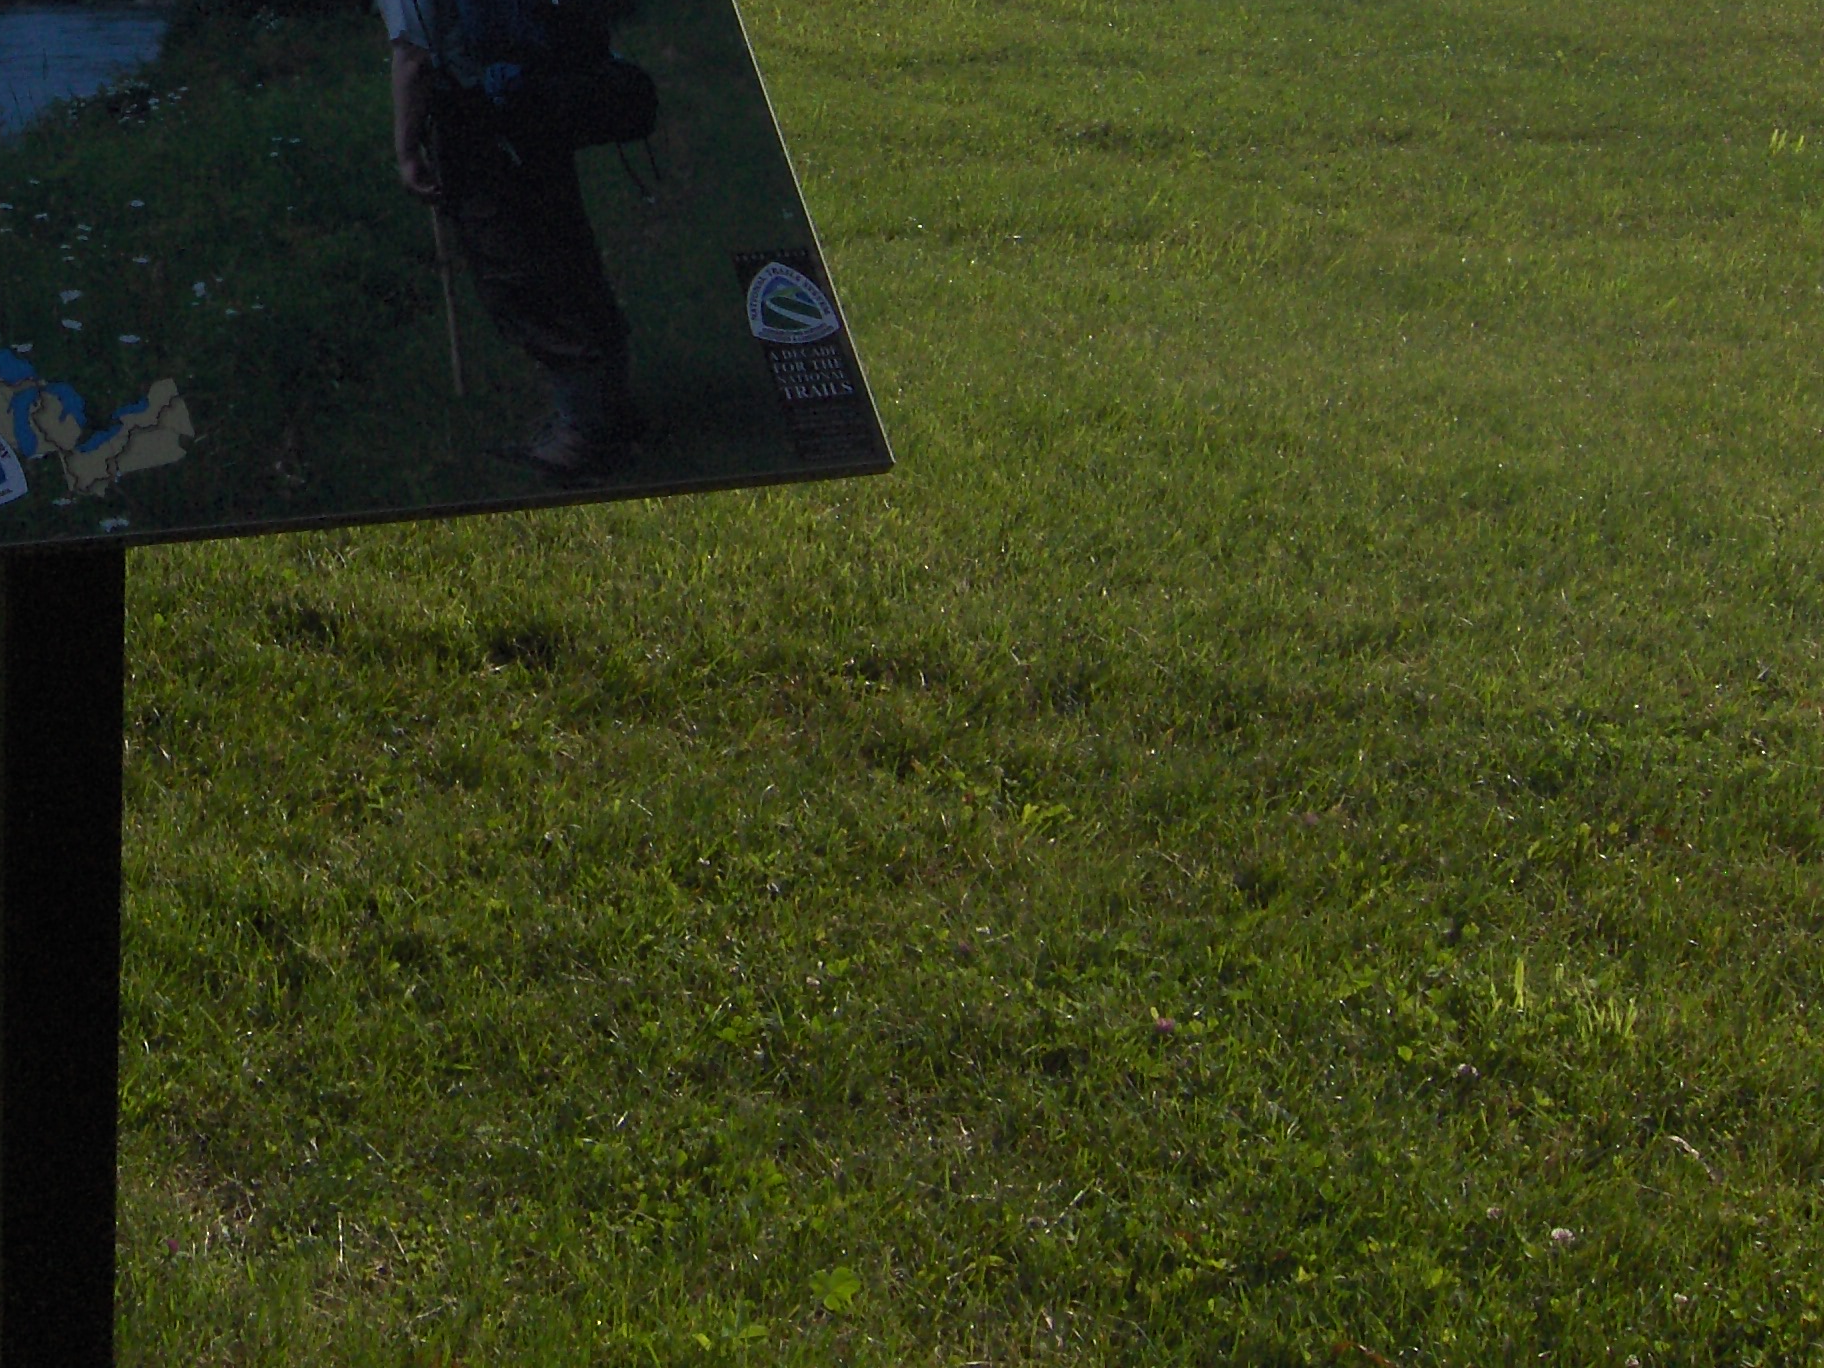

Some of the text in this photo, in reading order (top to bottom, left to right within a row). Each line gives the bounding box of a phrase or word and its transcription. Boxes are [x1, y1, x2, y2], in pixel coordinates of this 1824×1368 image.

[750, 266, 831, 321] NATIONAL TRAILS SYSTEM
[770, 345, 838, 362] A DECADE
[772, 358, 843, 375] FOR THE
[777, 369, 846, 385] NATIONAL
[783, 381, 855, 400] TRAILS
